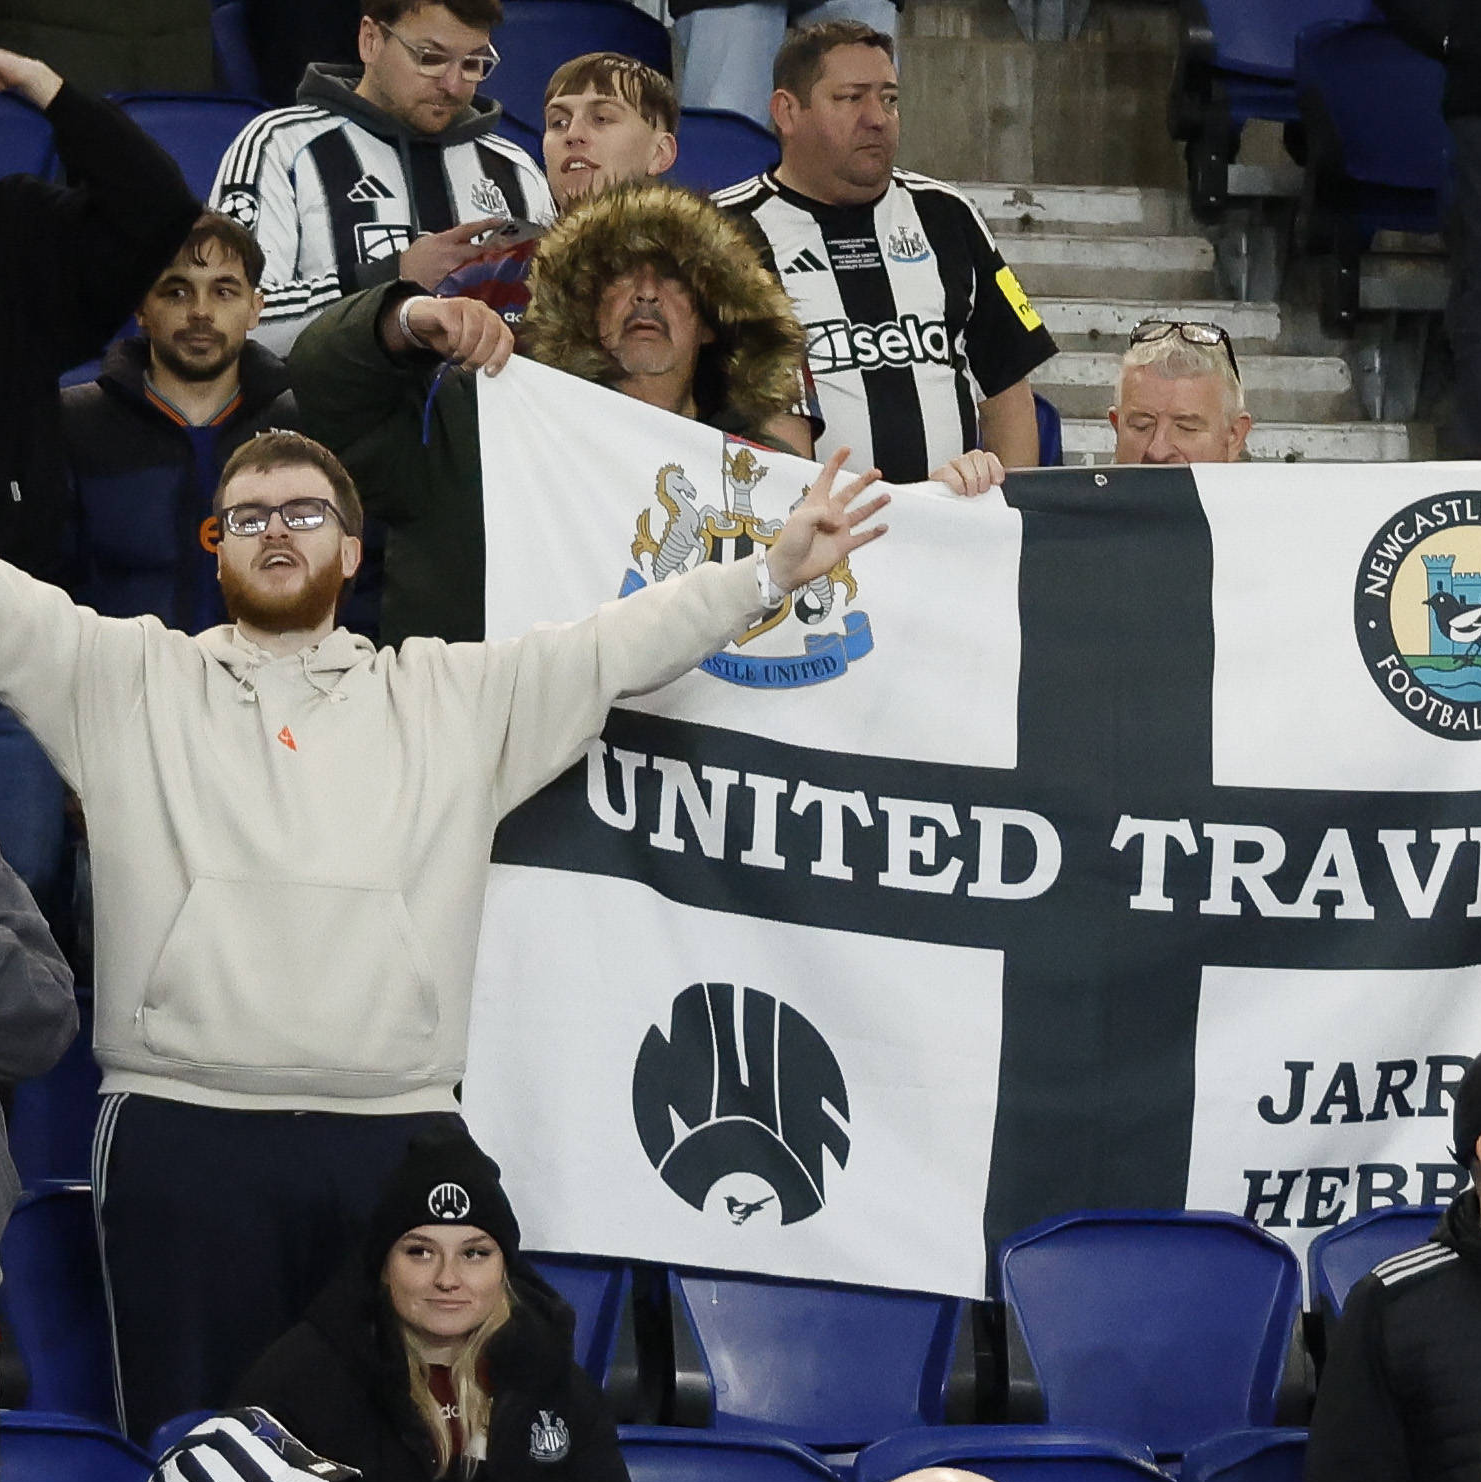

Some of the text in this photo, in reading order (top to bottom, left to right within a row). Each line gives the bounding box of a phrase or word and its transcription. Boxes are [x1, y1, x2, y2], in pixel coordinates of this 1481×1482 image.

[853, 318, 949, 363] sela
[764, 655, 838, 684] UNITED
[584, 741, 1062, 900] UNITED
